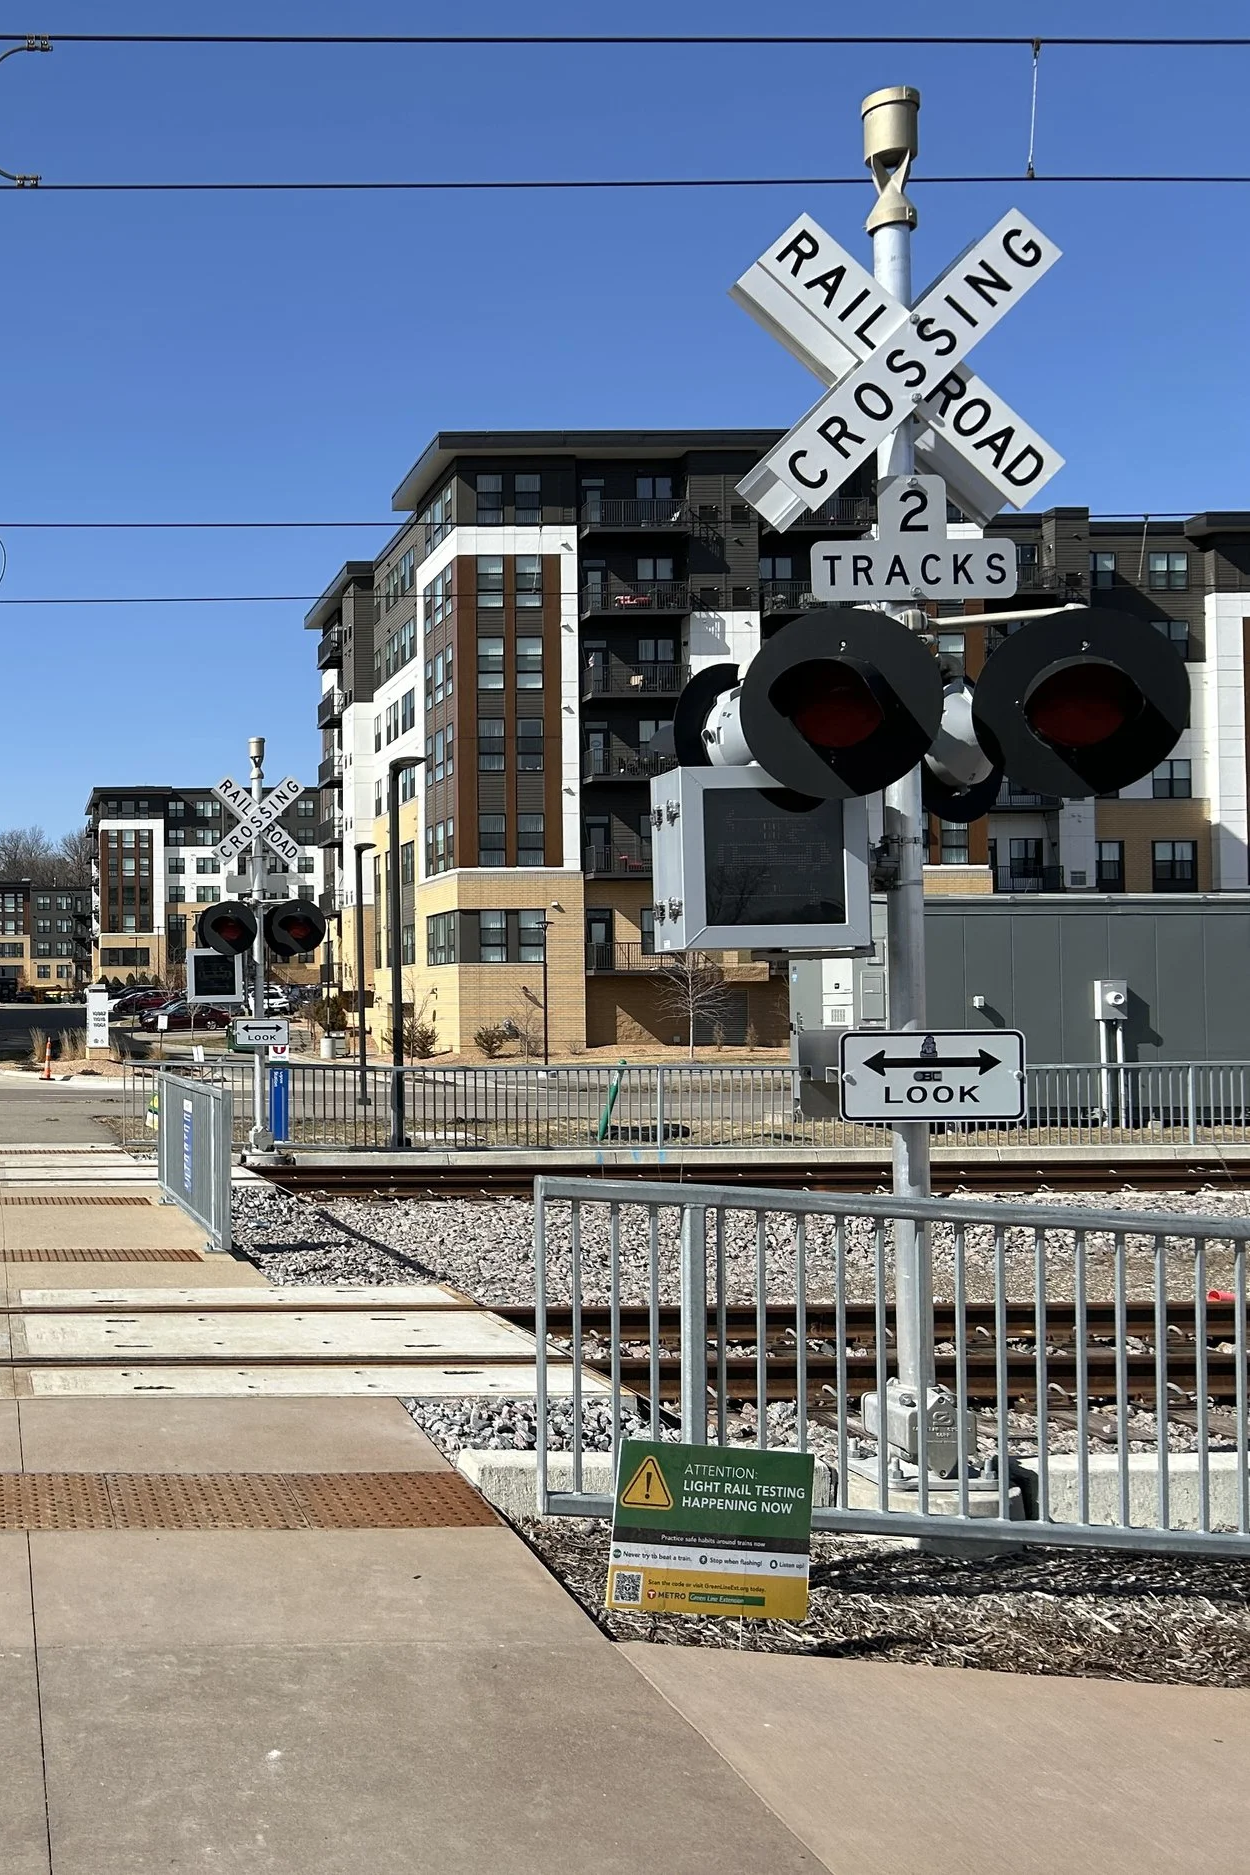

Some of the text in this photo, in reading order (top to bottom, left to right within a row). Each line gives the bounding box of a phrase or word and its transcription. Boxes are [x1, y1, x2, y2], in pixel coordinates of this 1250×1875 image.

[775, 229, 1045, 487] RAIL ROAD
[788, 228, 1042, 489] CROSSING
[899, 490, 929, 532] 2
[822, 553, 1007, 586] TRACKS
[219, 779, 298, 859] RAIL ROAD
[220, 780, 299, 858] CROSSING
[884, 1085, 981, 1104] LOOK
[684, 1463, 759, 1480] ATTENTION:
[683, 1479, 806, 1499] LIGHT RAIL TESTING
[681, 1495, 793, 1514] HAPPENING NOW
[661, 1534, 684, 1542] Practice
[716, 1538, 736, 1546] around
[659, 1553, 671, 1561] beat
[740, 1559, 762, 1568] flashing!
[658, 1591, 686, 1600] METRO
[704, 1583, 749, 1592] GreenLineExt.org
